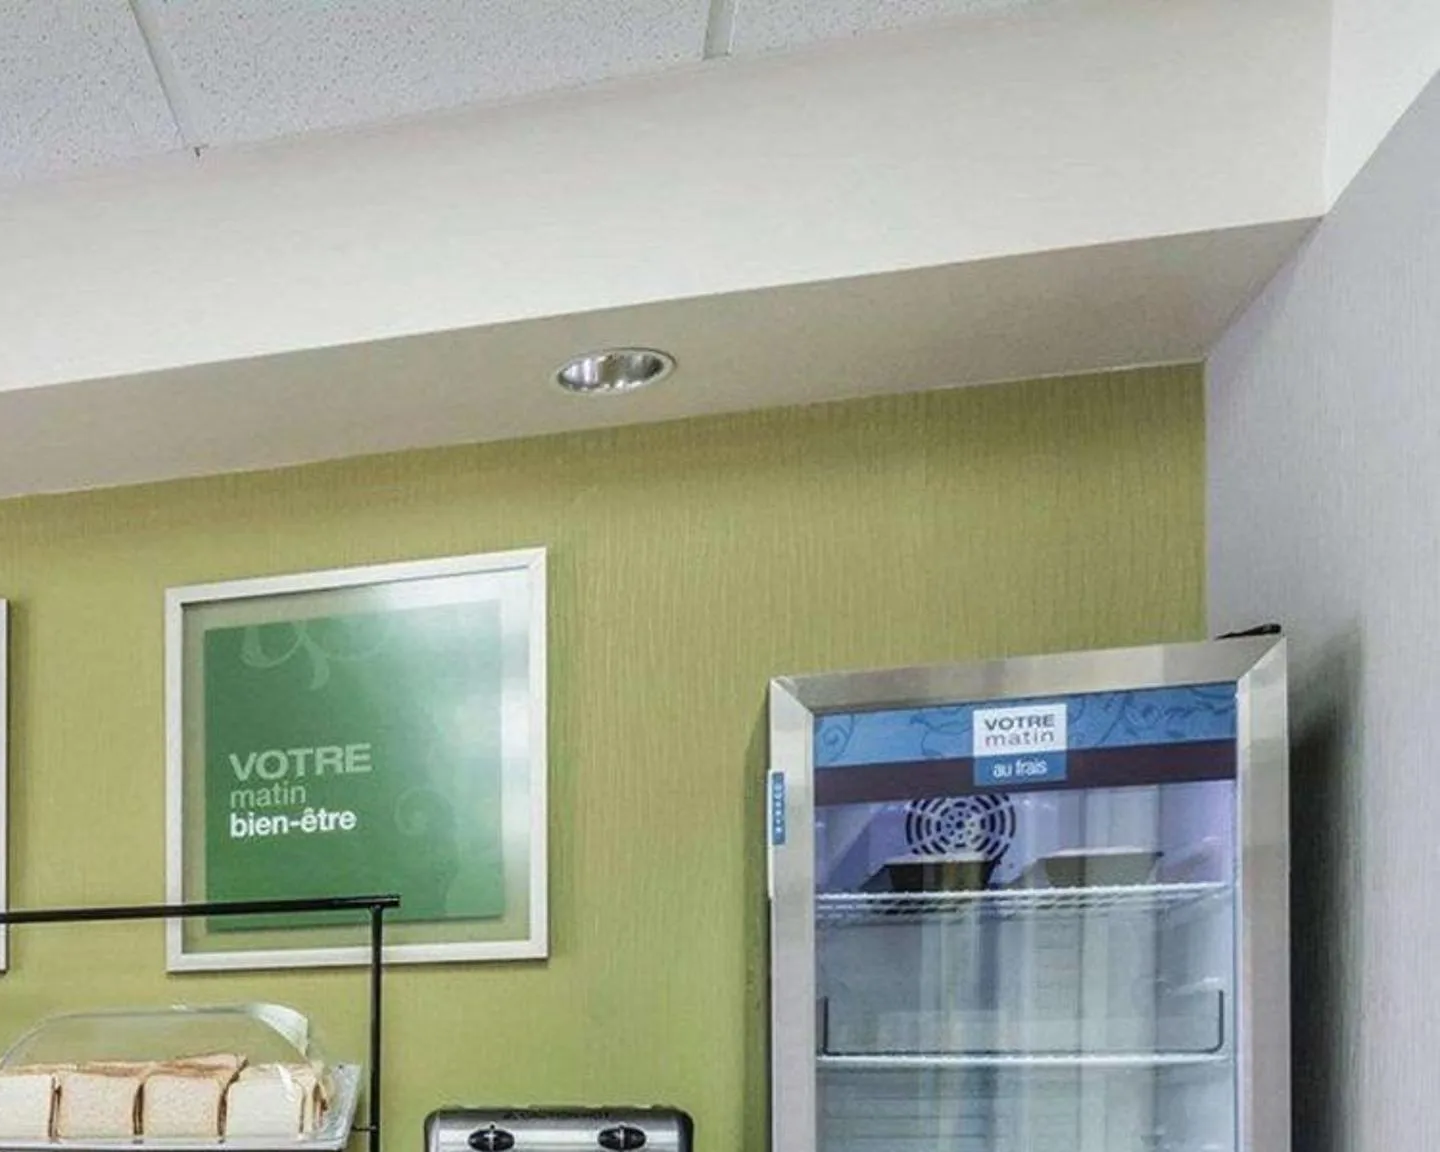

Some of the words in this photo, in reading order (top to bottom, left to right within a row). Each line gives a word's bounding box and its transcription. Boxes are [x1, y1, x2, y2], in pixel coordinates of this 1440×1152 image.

[984, 714, 1055, 731] VOTRE
[985, 729, 1055, 746] matin
[229, 743, 372, 781] VOTRE
[993, 763, 1013, 778] au
[1015, 758, 1048, 777] frais
[230, 780, 306, 808] matin
[230, 807, 357, 837] bien-être
